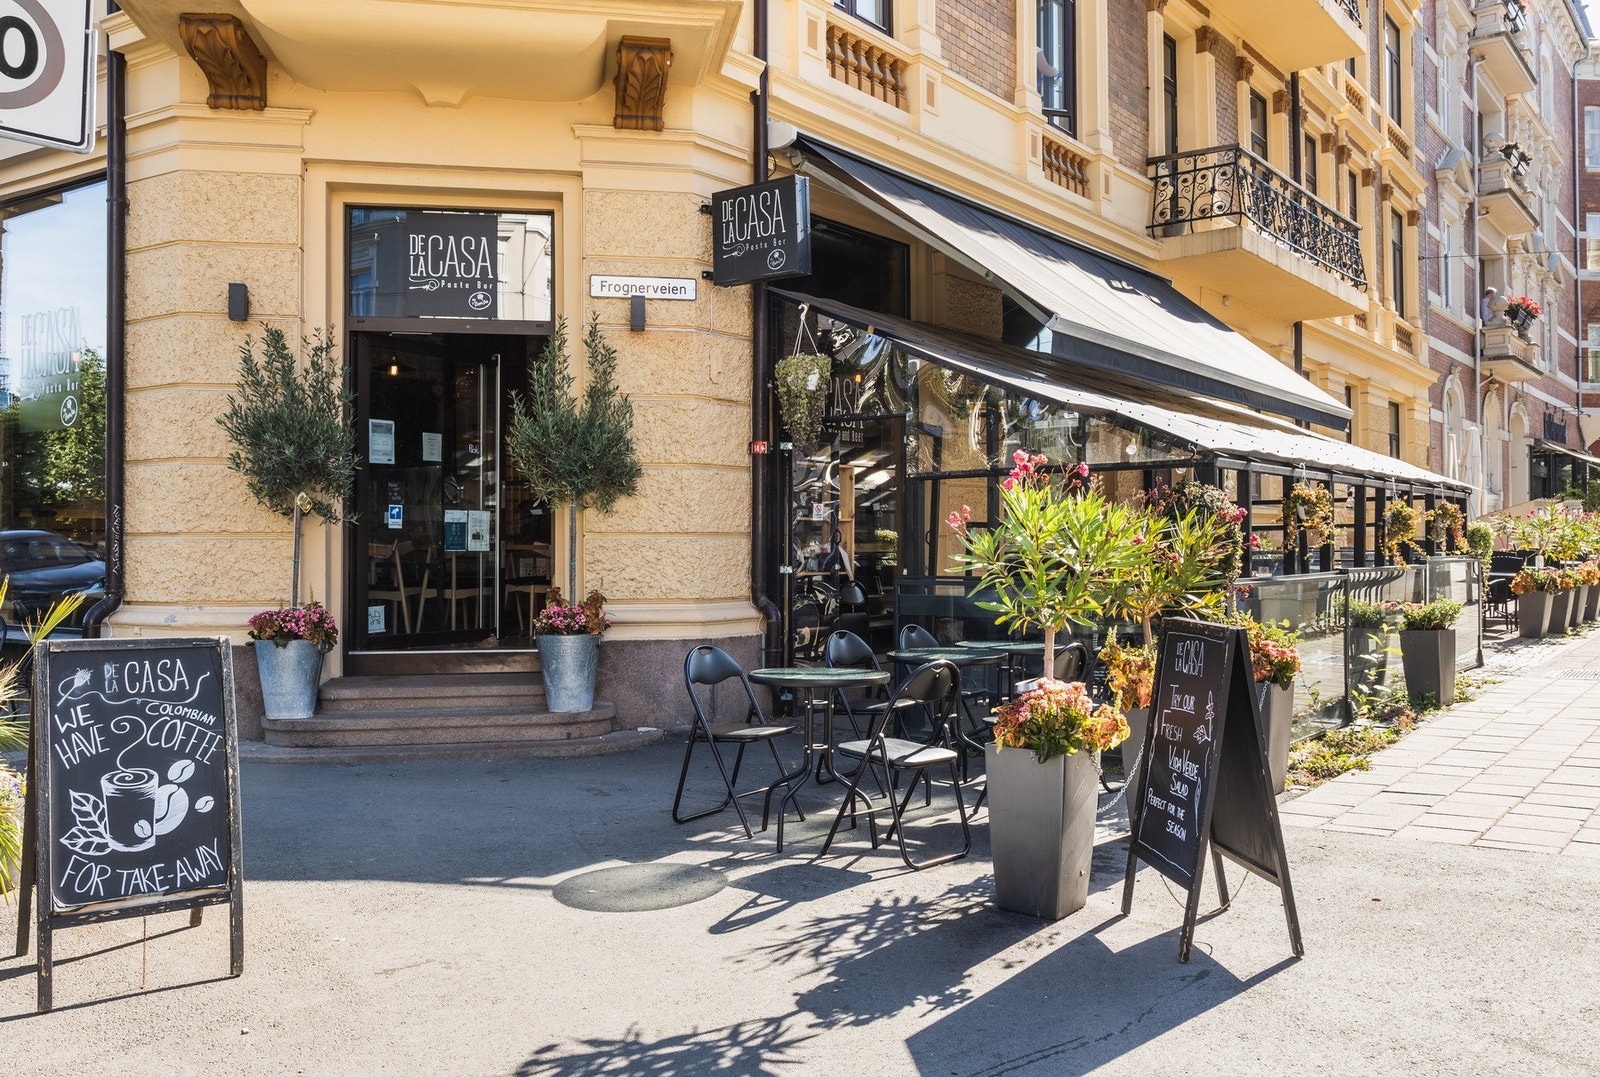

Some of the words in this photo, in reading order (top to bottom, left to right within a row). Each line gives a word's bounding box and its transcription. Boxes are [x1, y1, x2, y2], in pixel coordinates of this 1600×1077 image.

[722, 199, 734, 222] DE
[735, 189, 786, 241] CASA
[722, 222, 735, 244] LA
[409, 234, 426, 255] DE
[746, 242, 768, 252] Pasta
[773, 237, 786, 247] Bar
[410, 255, 427, 277] LA
[428, 234, 494, 278] CASA
[441, 279, 470, 289] Pasta
[477, 281, 493, 290] Bar
[600, 280, 687, 296] Frognerveien
[1176, 642, 1184, 656] DE
[1182, 640, 1205, 678] CASA
[103, 662, 119, 678] DE
[1175, 657, 1182, 671] LA
[104, 680, 119, 693] LA
[124, 658, 189, 694] CASA
[1182, 694, 1196, 711] OUR
[54, 703, 95, 734] WE
[145, 702, 216, 726] COLOMBIAN
[54, 723, 111, 770] HAVE
[146, 716, 224, 765] COFFEE
[1167, 802, 1176, 816] FOR
[1176, 806, 1186, 821] THE
[1165, 819, 1187, 842] SEASON
[59, 854, 112, 897] FOR
[115, 836, 224, 896] TAKE-AWAY
